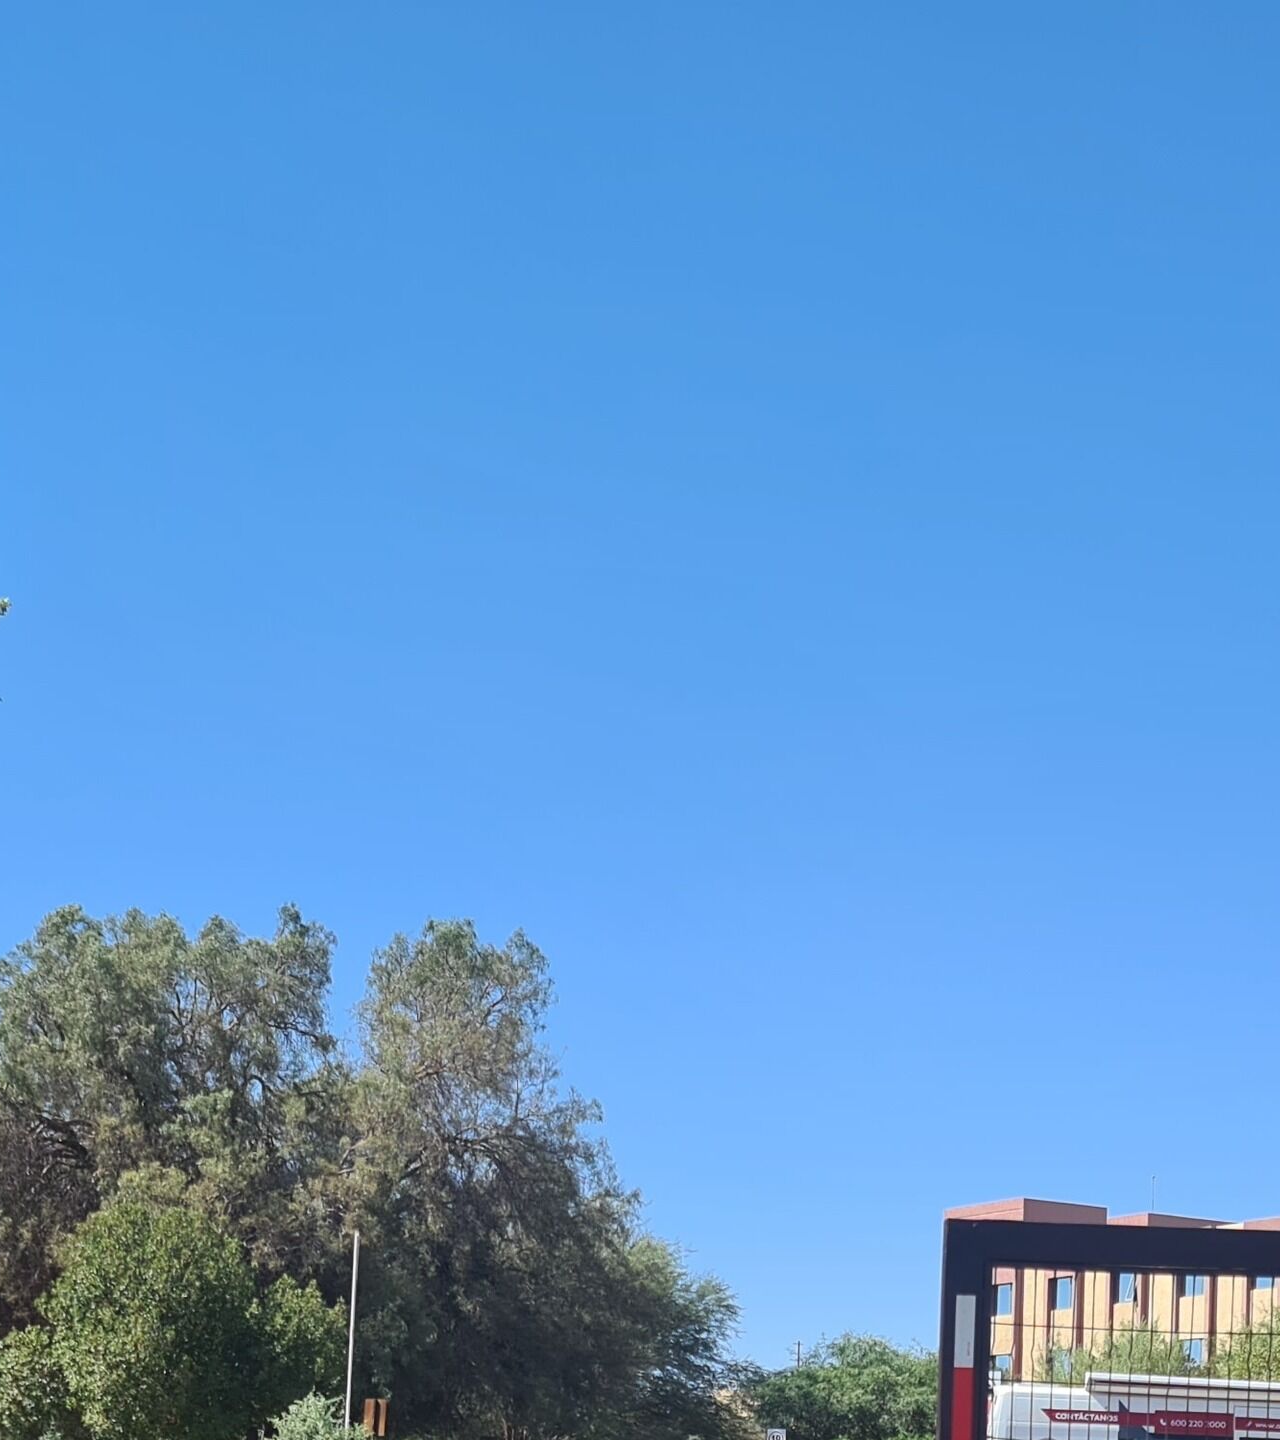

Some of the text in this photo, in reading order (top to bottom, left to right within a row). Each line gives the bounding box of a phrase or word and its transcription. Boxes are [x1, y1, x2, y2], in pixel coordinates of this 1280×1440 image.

[1170, 1419, 1227, 1429] 600 220 000
